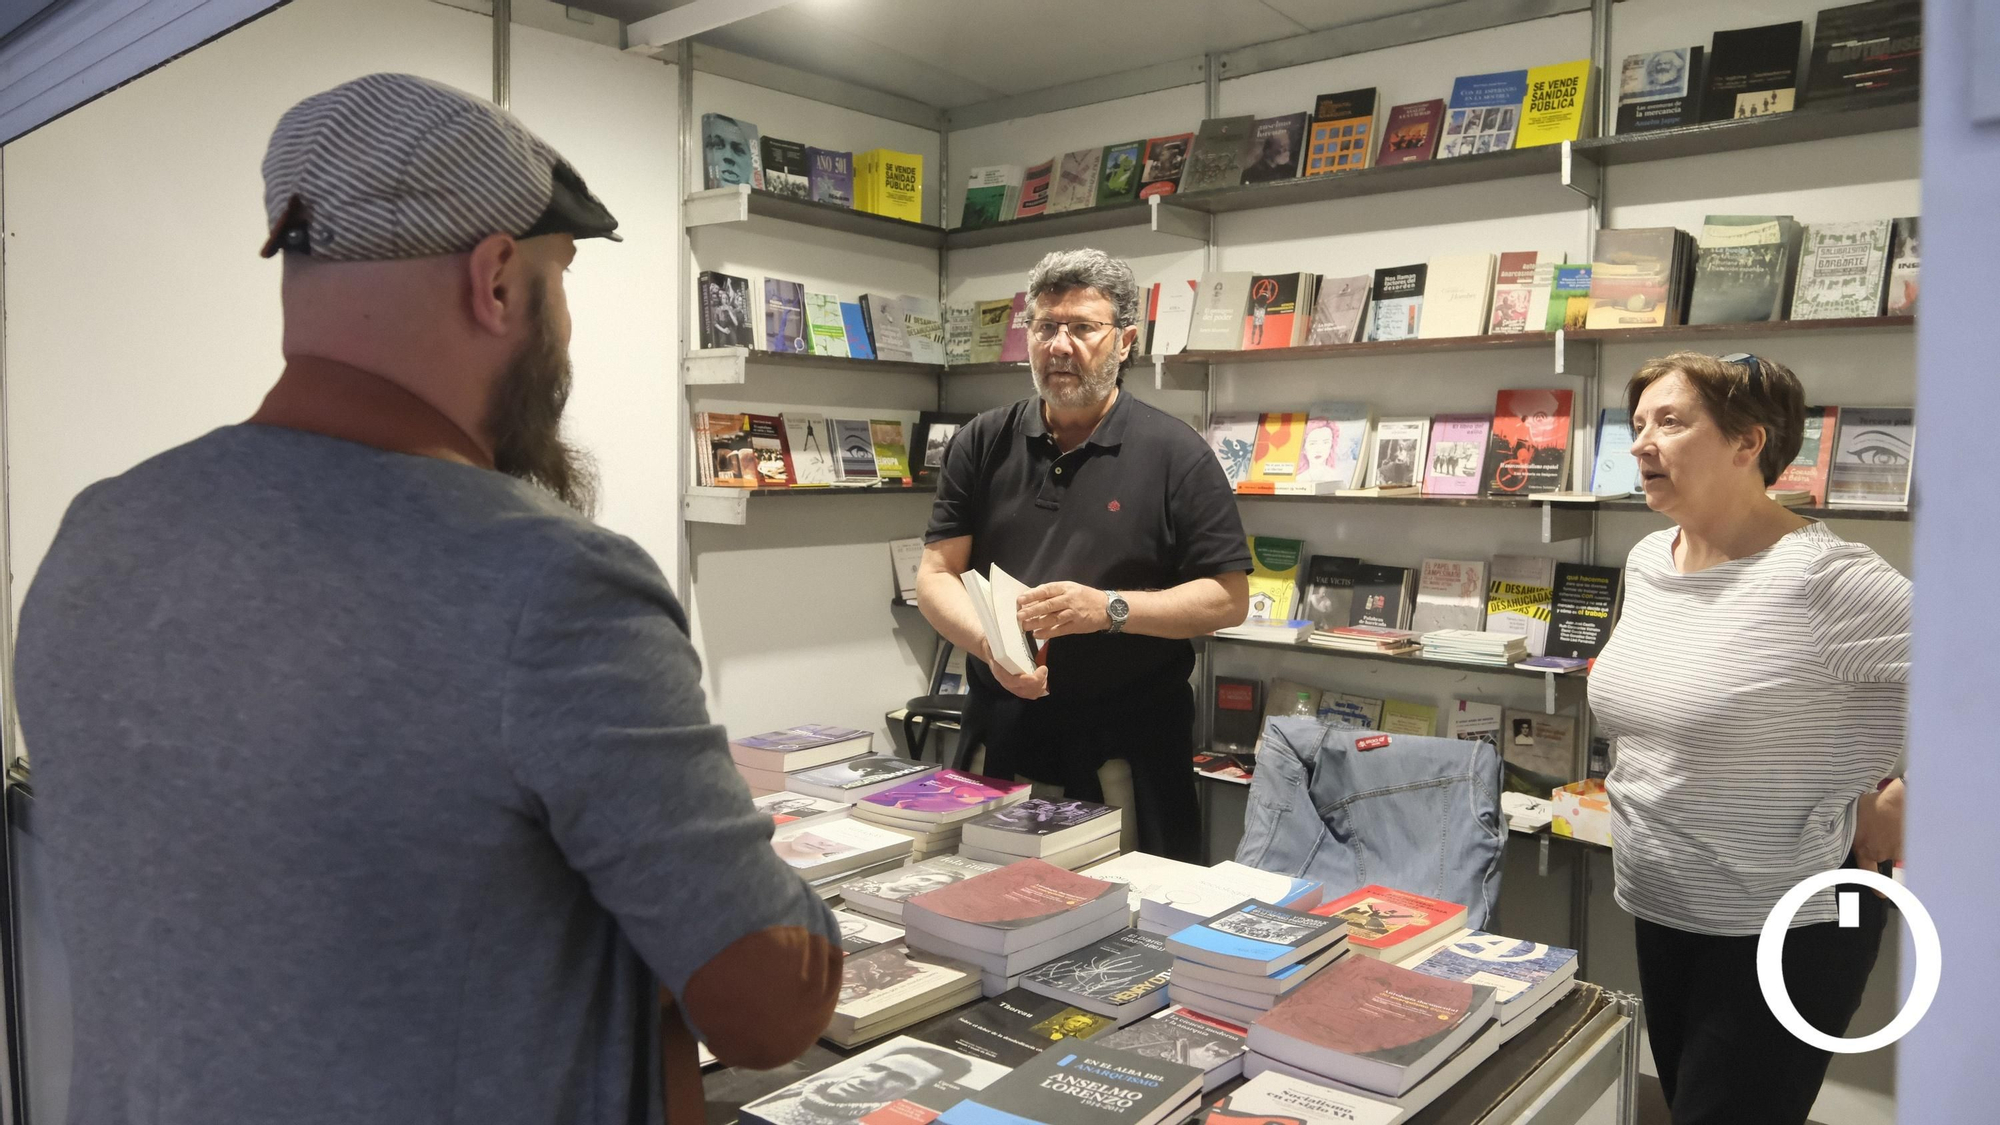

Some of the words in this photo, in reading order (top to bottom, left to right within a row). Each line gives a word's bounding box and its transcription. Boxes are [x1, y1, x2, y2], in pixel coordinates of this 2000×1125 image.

[1533, 81, 1545, 92] SE
[1548, 77, 1579, 90] VENDE
[1531, 87, 1577, 102] SANIDAD
[1530, 97, 1574, 113] PÚBLICA
[816, 154, 833, 172] AÑO
[885, 162, 894, 173] SE
[894, 164, 916, 176] VENDE
[885, 170, 916, 184] SANIDAD
[885, 179, 916, 192] PÚBLICA
[1818, 257, 1865, 268] BARBARIE
[1396, 273, 1416, 281] llaman
[1383, 283, 1416, 291] desorden
[1505, 583, 1549, 595] DESAHUC
[1490, 590, 1554, 612] DESAHUCIADAS
[1585, 609, 1608, 618] trabajo
[1139, 934, 1164, 946] Diario
[1108, 980, 1155, 1003] HENRY
[999, 1001, 1034, 1018] Thoreau
[1179, 1019, 1205, 1030] ciencia
[1205, 1027, 1239, 1041] moderna
[1074, 1063, 1159, 1088] ANARQUISMO
[1083, 1057, 1100, 1068] EN
[1100, 1061, 1114, 1070] EL
[1114, 1064, 1143, 1078] ALBA
[1143, 1071, 1165, 1082] DEL
[1039, 1078, 1134, 1109] LORENZO
[1049, 1071, 1143, 1101] ANSELMO
[1080, 1098, 1125, 1113] 1914-2014
[1280, 1089, 1353, 1114] Socialismo
[1298, 1100, 1330, 1115] siglo
[1332, 1108, 1357, 1122] XIX
